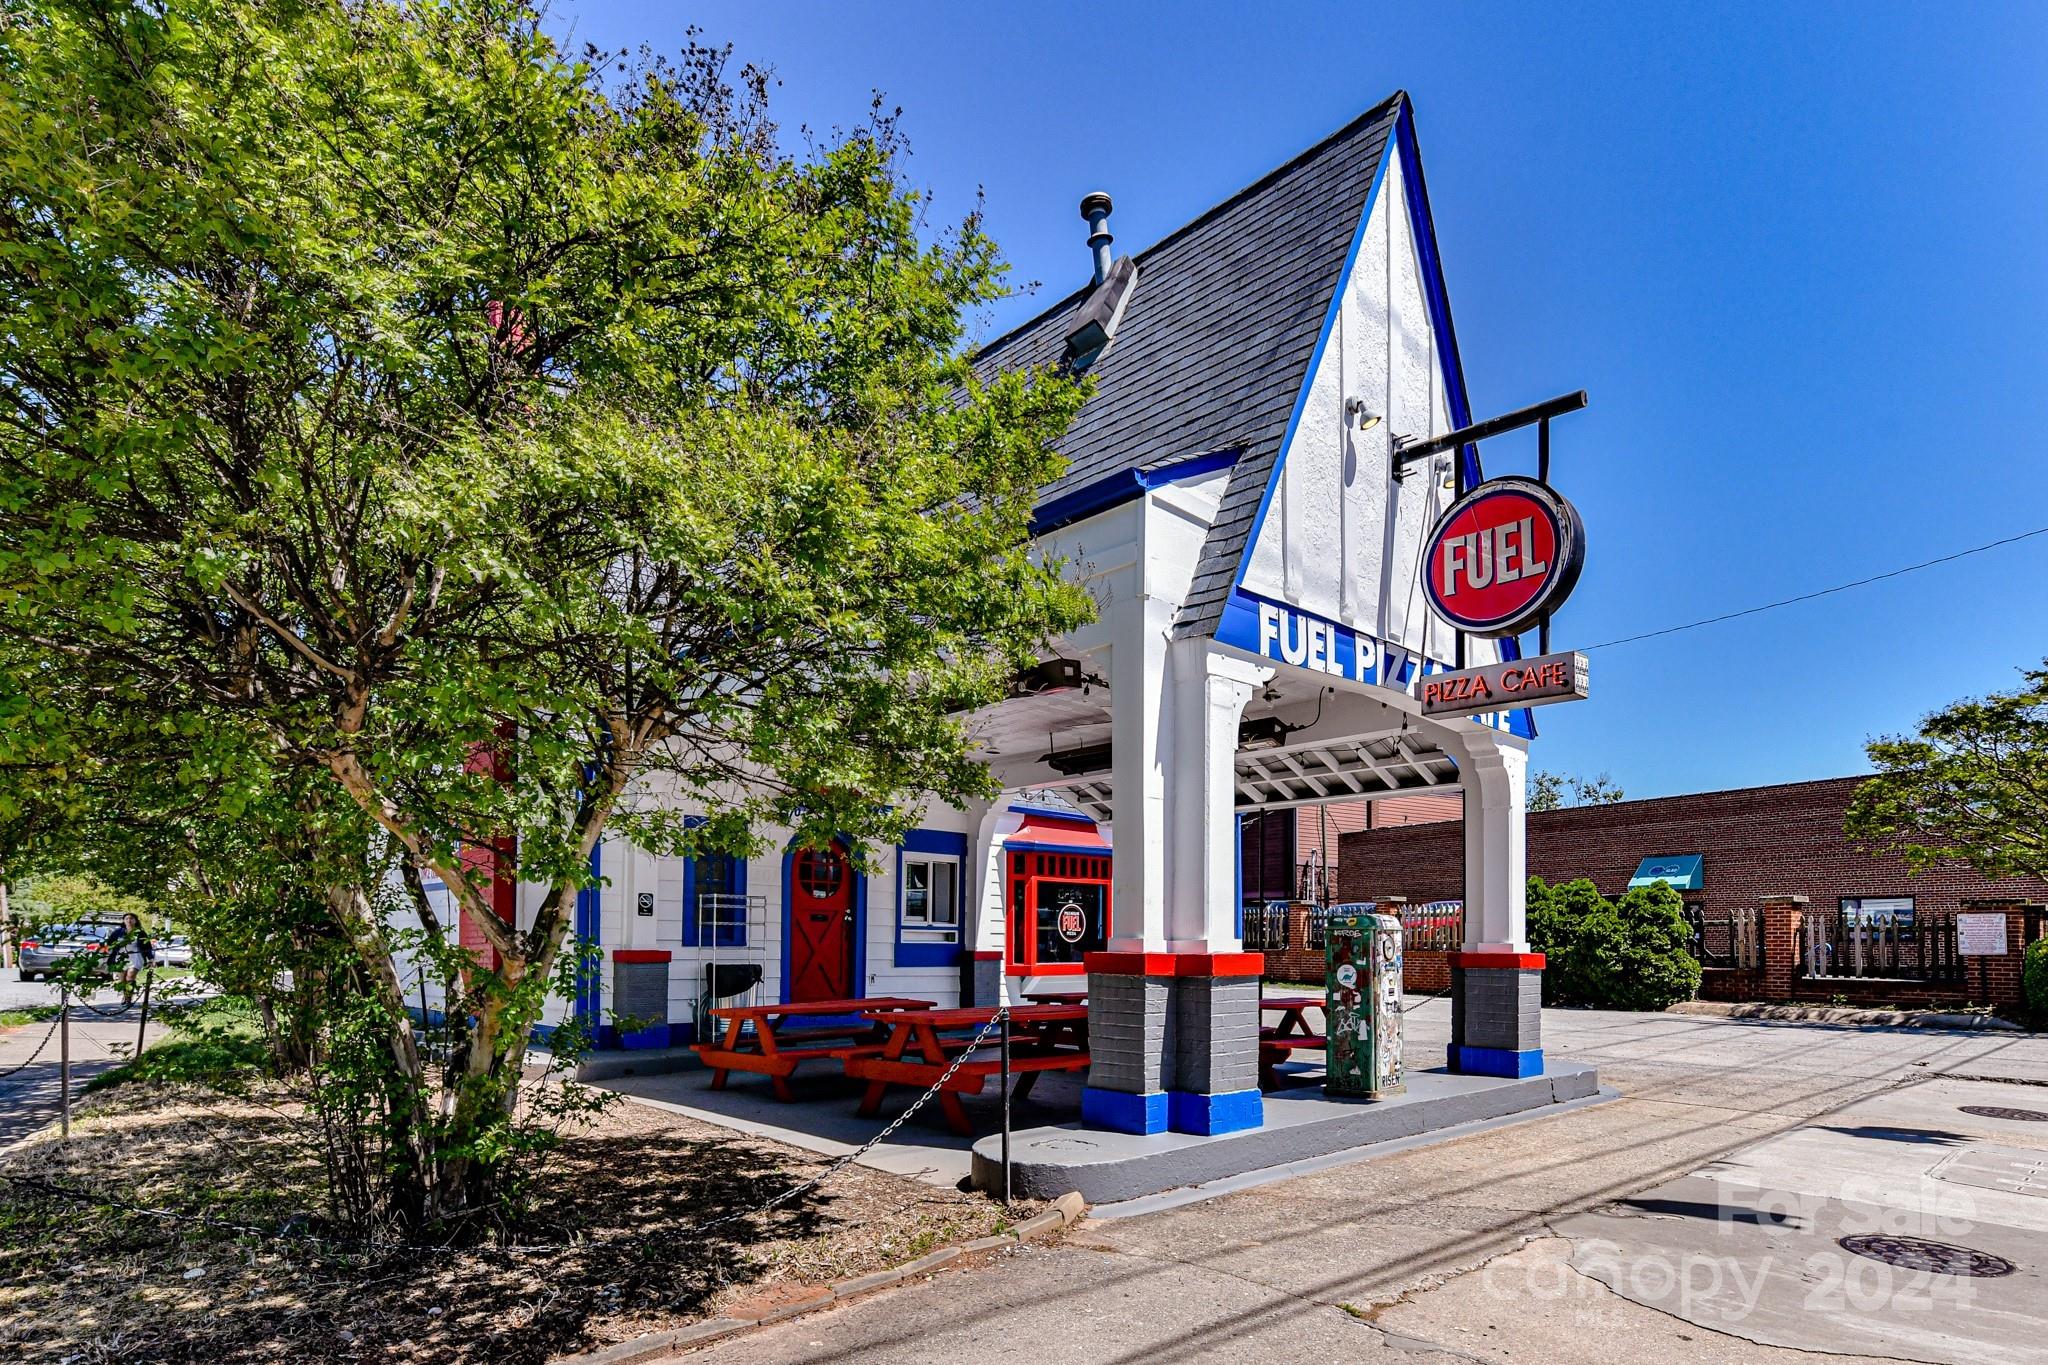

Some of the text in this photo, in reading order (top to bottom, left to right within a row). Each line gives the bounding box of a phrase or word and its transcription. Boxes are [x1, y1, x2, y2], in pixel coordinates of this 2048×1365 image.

[1443, 516, 1546, 597] FUEL
[1258, 601, 1444, 698] FUEL PIZZ
[1424, 674, 1490, 705] PIZZA
[1500, 661, 1565, 694] CAFE
[1382, 1074, 1400, 1087] RISEN
